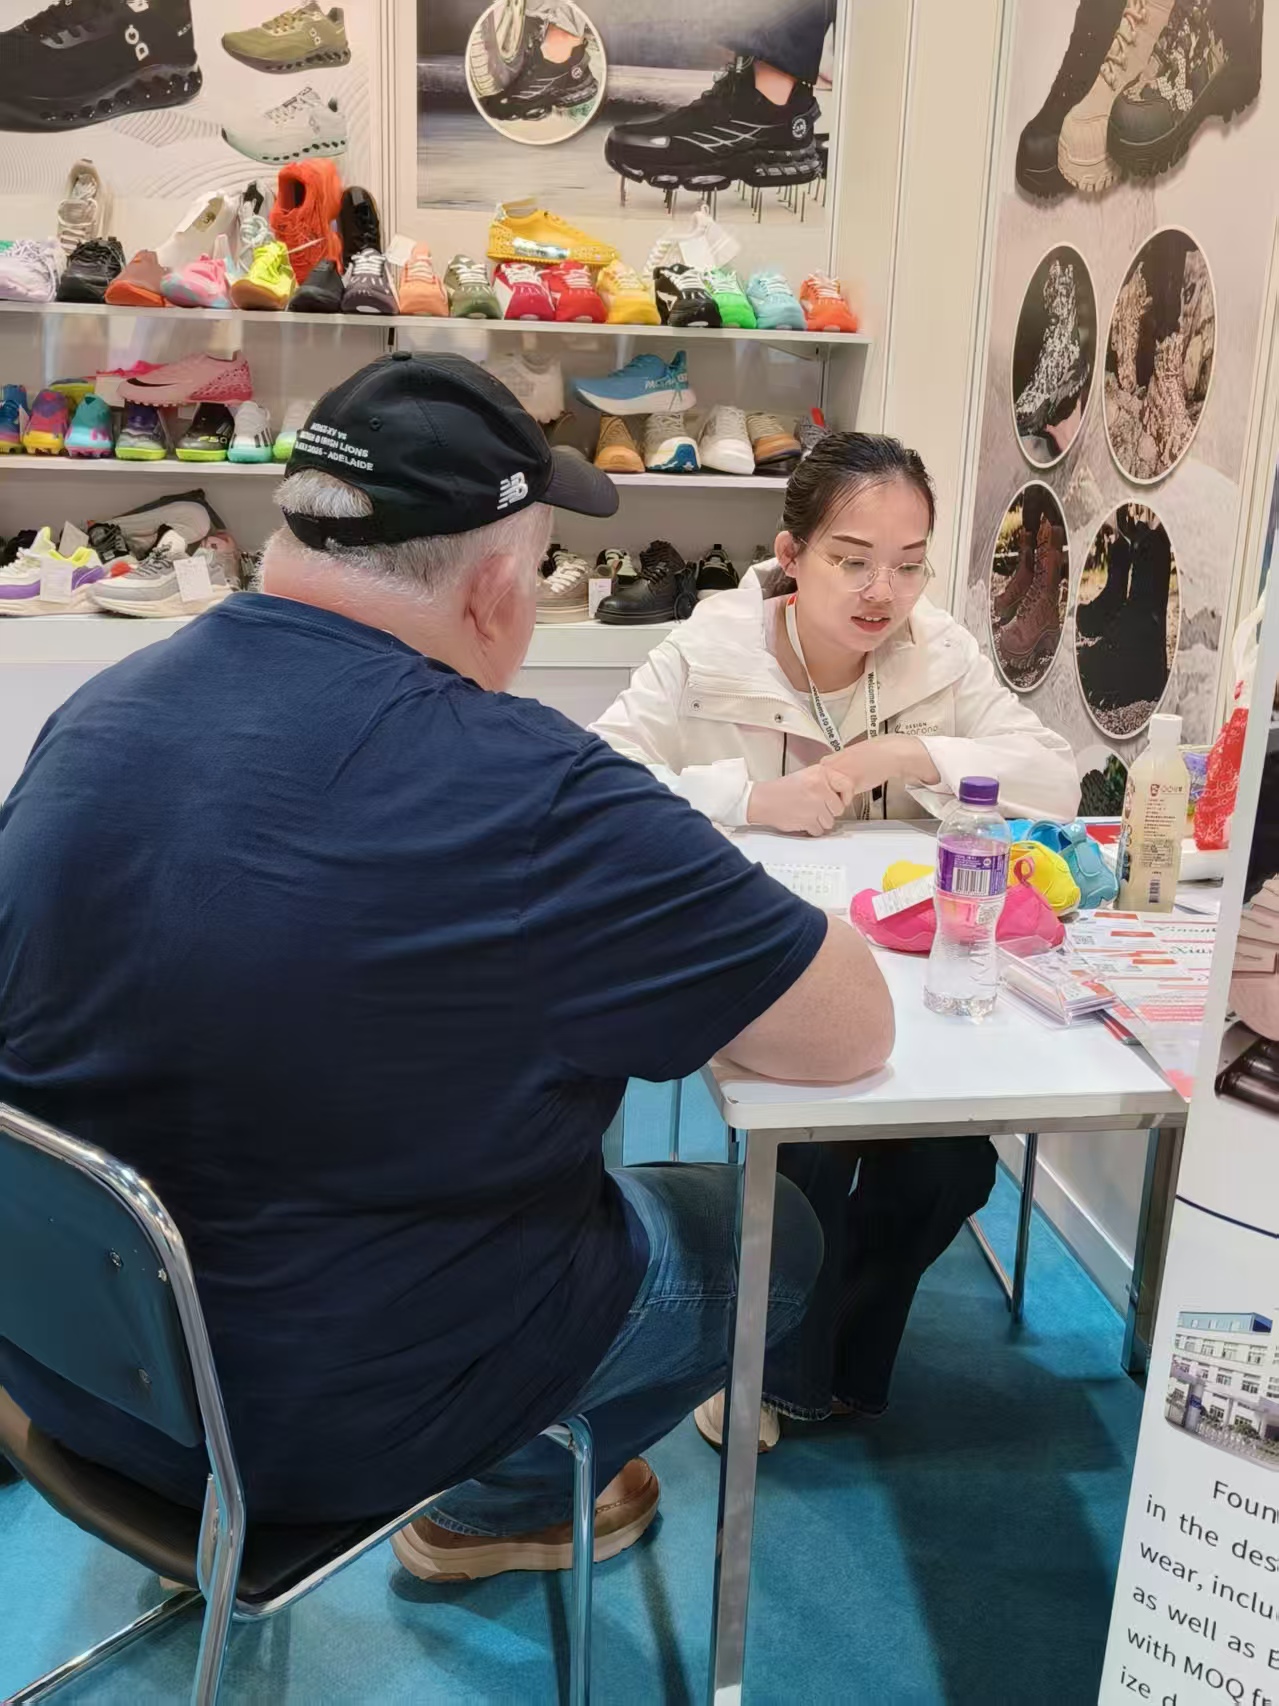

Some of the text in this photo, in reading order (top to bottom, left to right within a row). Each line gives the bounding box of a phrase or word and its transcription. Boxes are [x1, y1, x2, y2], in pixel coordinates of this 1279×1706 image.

[327, 451, 374, 471] ADELAIDE
[340, 442, 369, 458] LIONS
[867, 671, 875, 705] Welcome
[869, 705, 876, 714] to
[825, 726, 835, 739] the
[1213, 1480, 1279, 1525] Foun
[1146, 1493, 1279, 1573] in the des
[1140, 1541, 1279, 1620] wear, inclu
[1133, 1586, 1157, 1611] as
[1168, 1604, 1217, 1641] well
[1227, 1635, 1255, 1658] as
[1120, 1665, 1151, 1699] ize
[1127, 1627, 1176, 1668] with
[1183, 1655, 1245, 1706] MOQ
